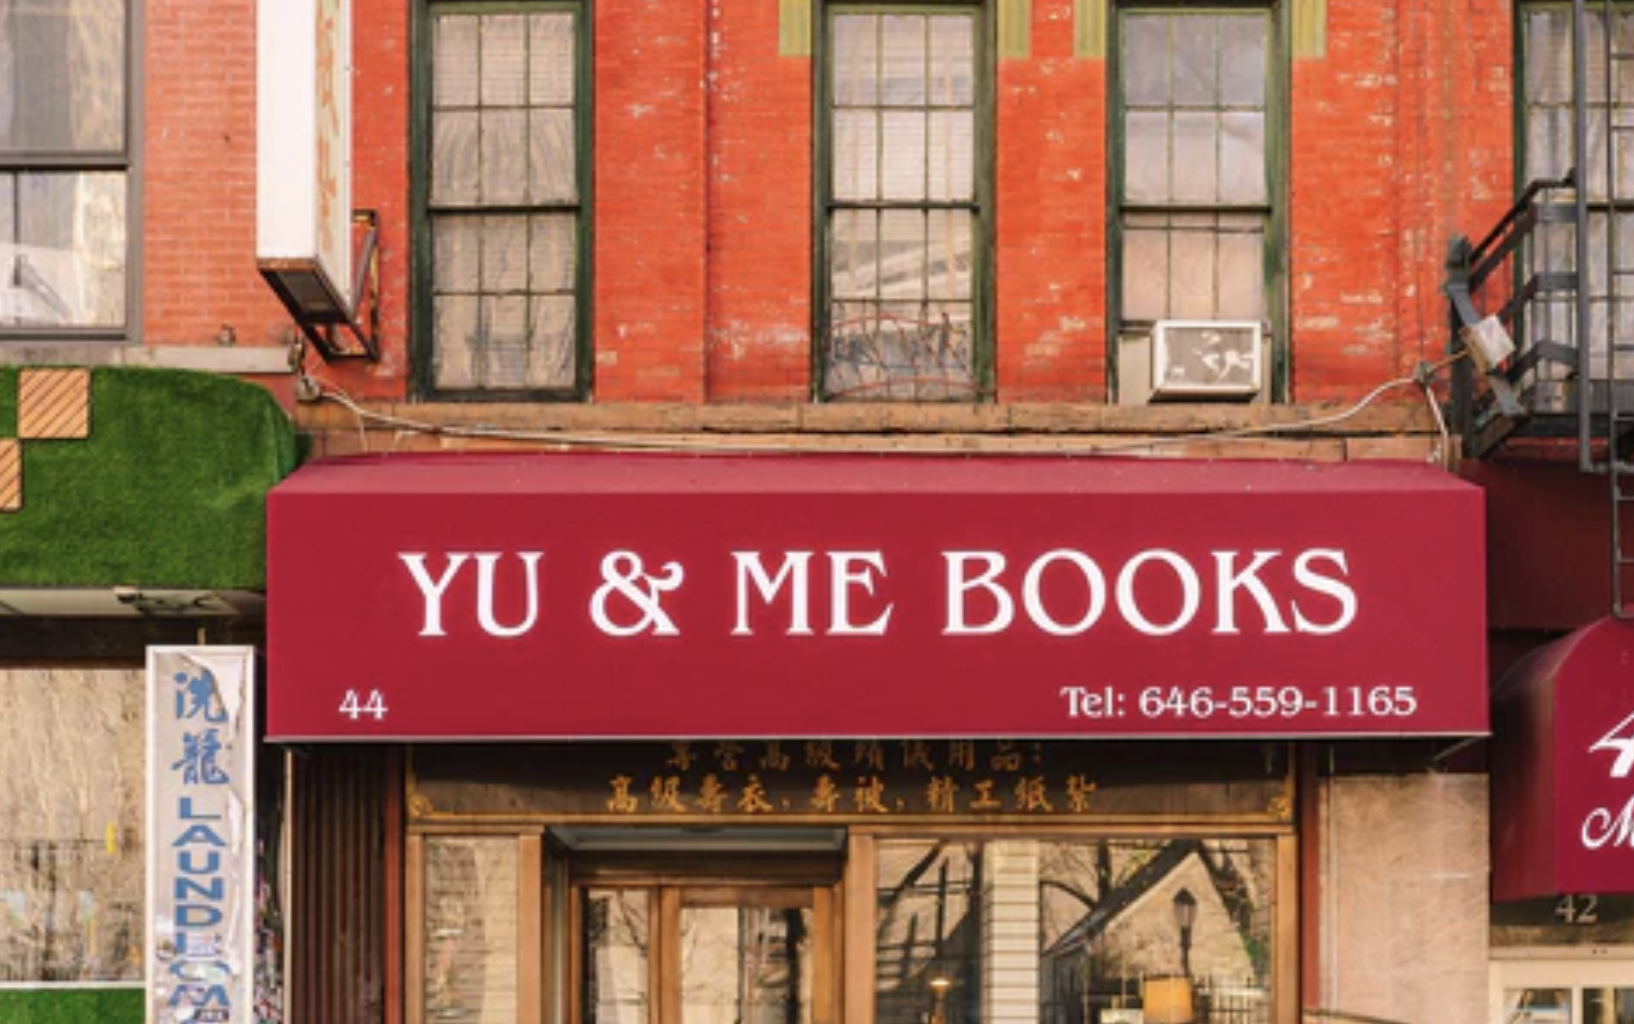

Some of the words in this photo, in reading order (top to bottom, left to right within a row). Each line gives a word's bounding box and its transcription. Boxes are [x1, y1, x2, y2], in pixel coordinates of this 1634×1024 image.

[398, 551, 544, 638] YU
[589, 549, 685, 638] &
[730, 550, 895, 637] ME
[941, 547, 1358, 637] BOOKS
[337, 688, 389, 720] 44
[1059, 685, 1126, 718] Tel:
[1138, 685, 1418, 718] 646-559-1165
[1553, 894, 1599, 924] 42
